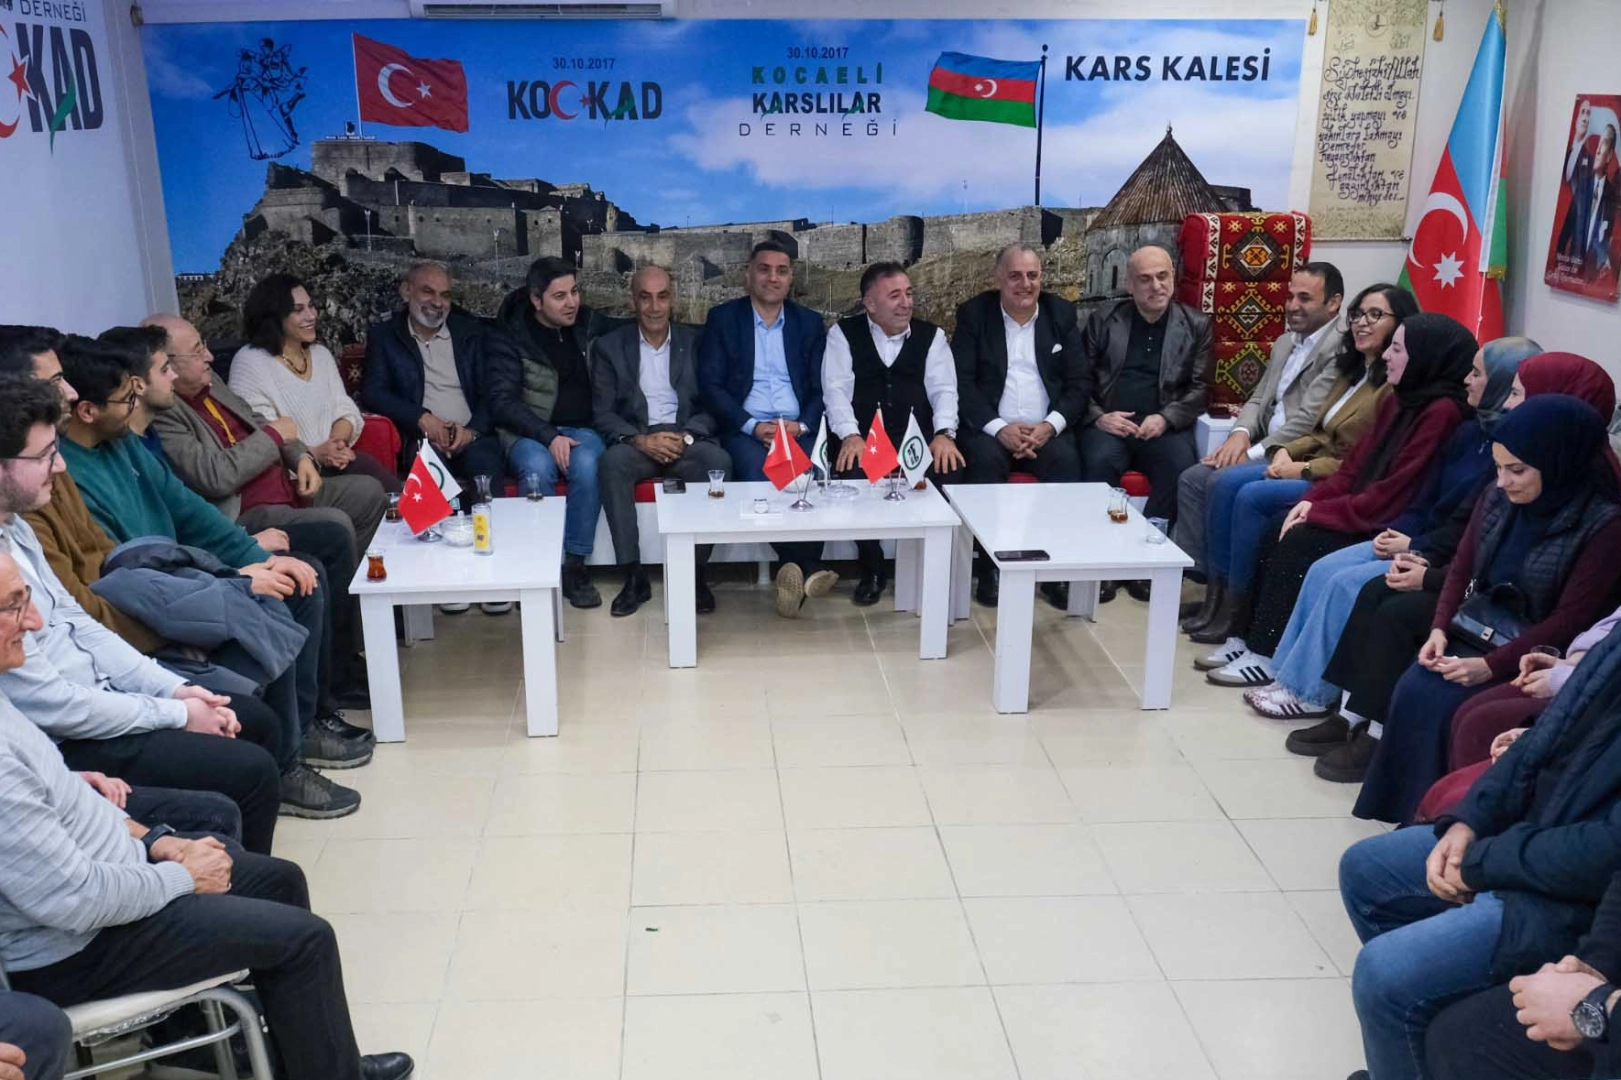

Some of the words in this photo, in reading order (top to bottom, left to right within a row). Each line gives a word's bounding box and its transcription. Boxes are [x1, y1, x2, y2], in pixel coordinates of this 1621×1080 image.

[787, 47, 849, 59] 30.10.2017
[553, 57, 616, 70] 30.10.2017
[752, 62, 883, 84] KOCAELİ
[1065, 55, 1151, 82] KARS
[1162, 47, 1271, 82] KALESİ
[752, 91, 882, 115] KARSLILAR
[738, 119, 897, 137] DERNEĞİ
